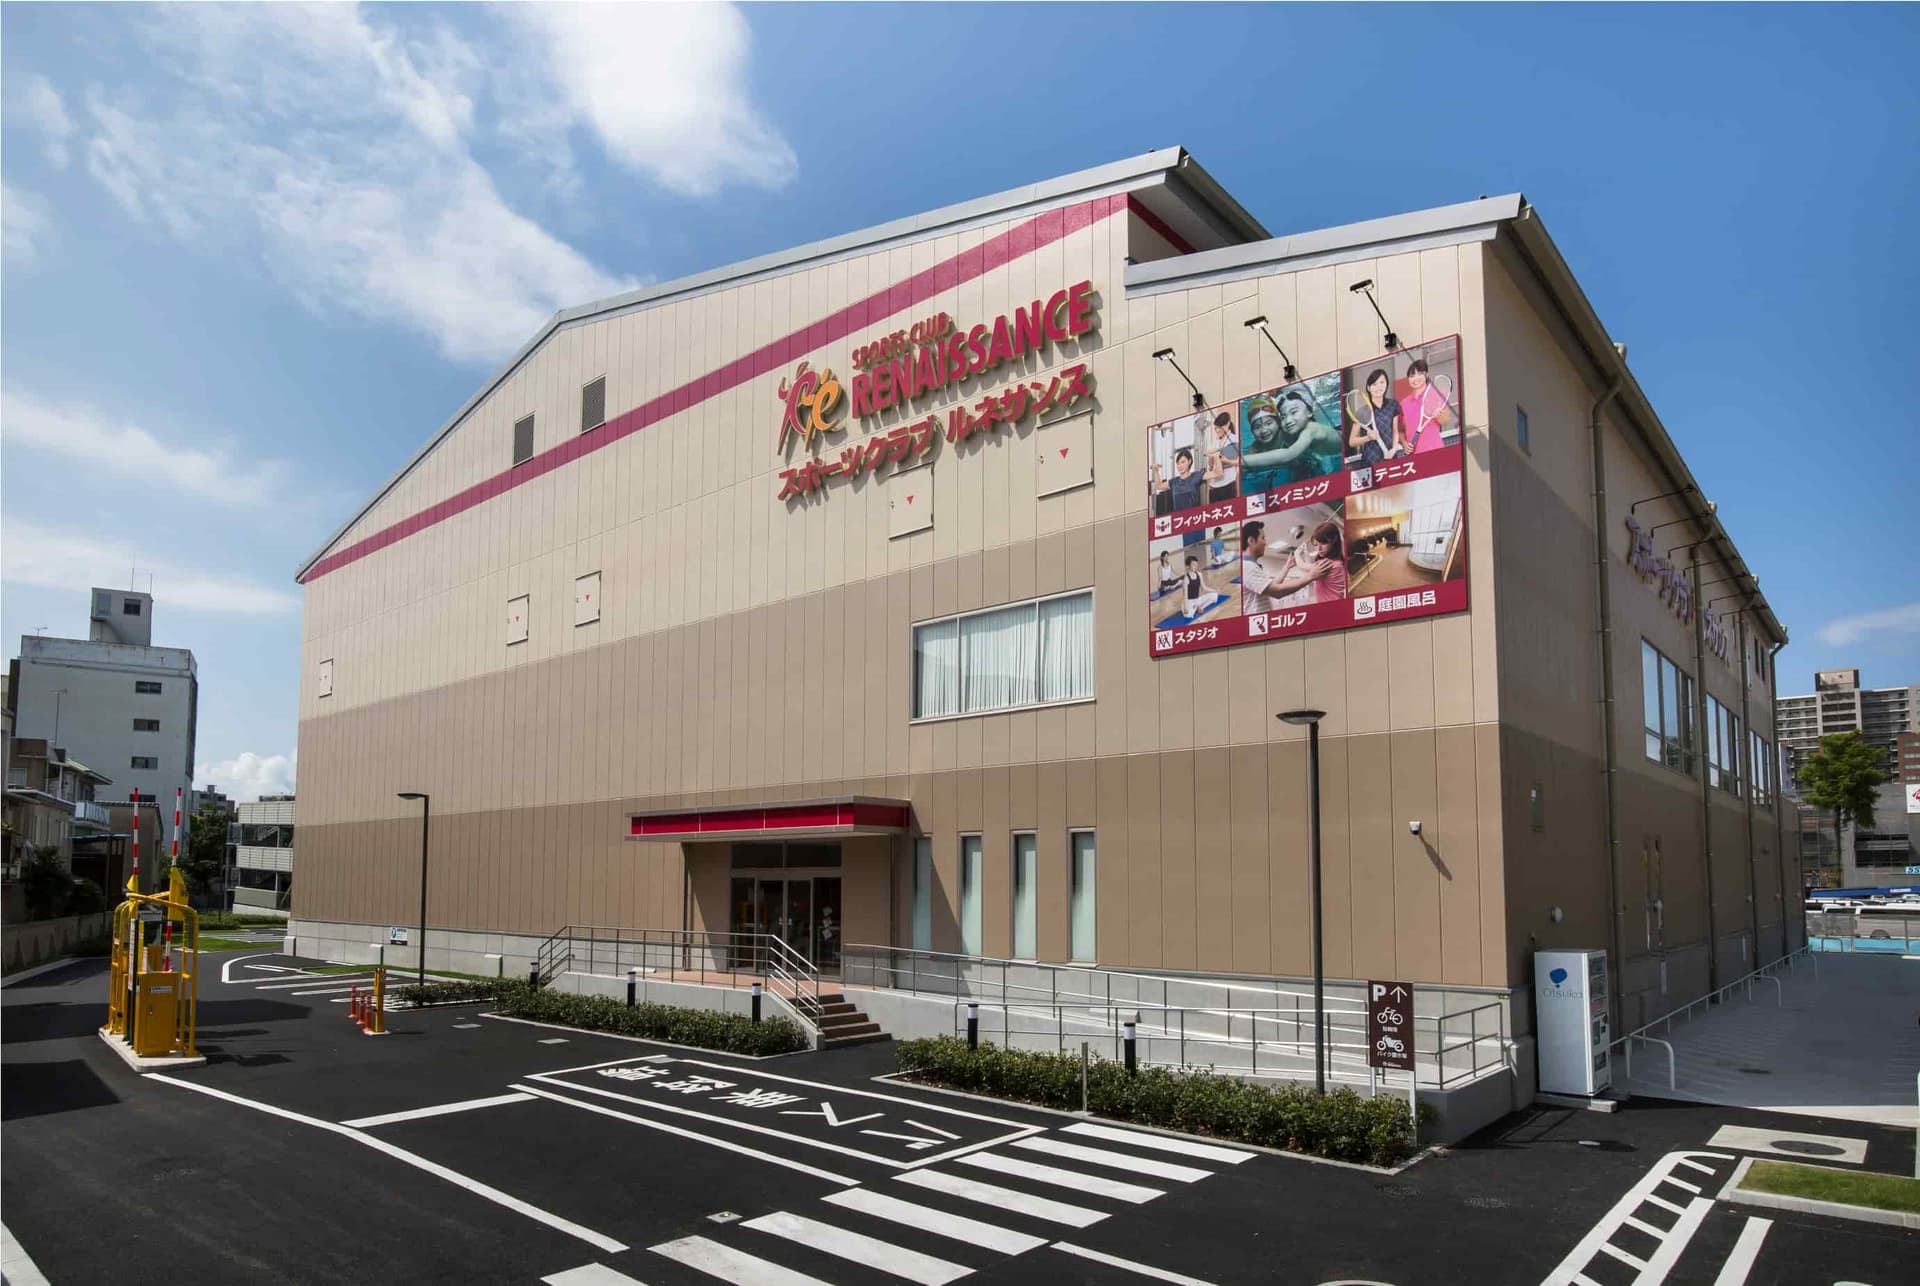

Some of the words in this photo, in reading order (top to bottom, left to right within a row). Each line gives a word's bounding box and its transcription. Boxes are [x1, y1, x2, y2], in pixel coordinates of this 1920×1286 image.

[852, 328, 906, 370] SPORTS
[909, 311, 950, 346] CLUB
[852, 280, 1093, 420] RENAISSANCE
[777, 415, 936, 502] スポーツクラブ
[945, 363, 1090, 443] ルネサンス
[1374, 461, 1417, 483] テニス
[1268, 480, 1330, 507] スイミング
[1173, 504, 1235, 530] フィットネス
[1270, 611, 1308, 630] ゴルフ
[1175, 626, 1219, 645] スタジオ
[1372, 984, 1387, 1002] P
[1542, 987, 1583, 999] Otsuka
